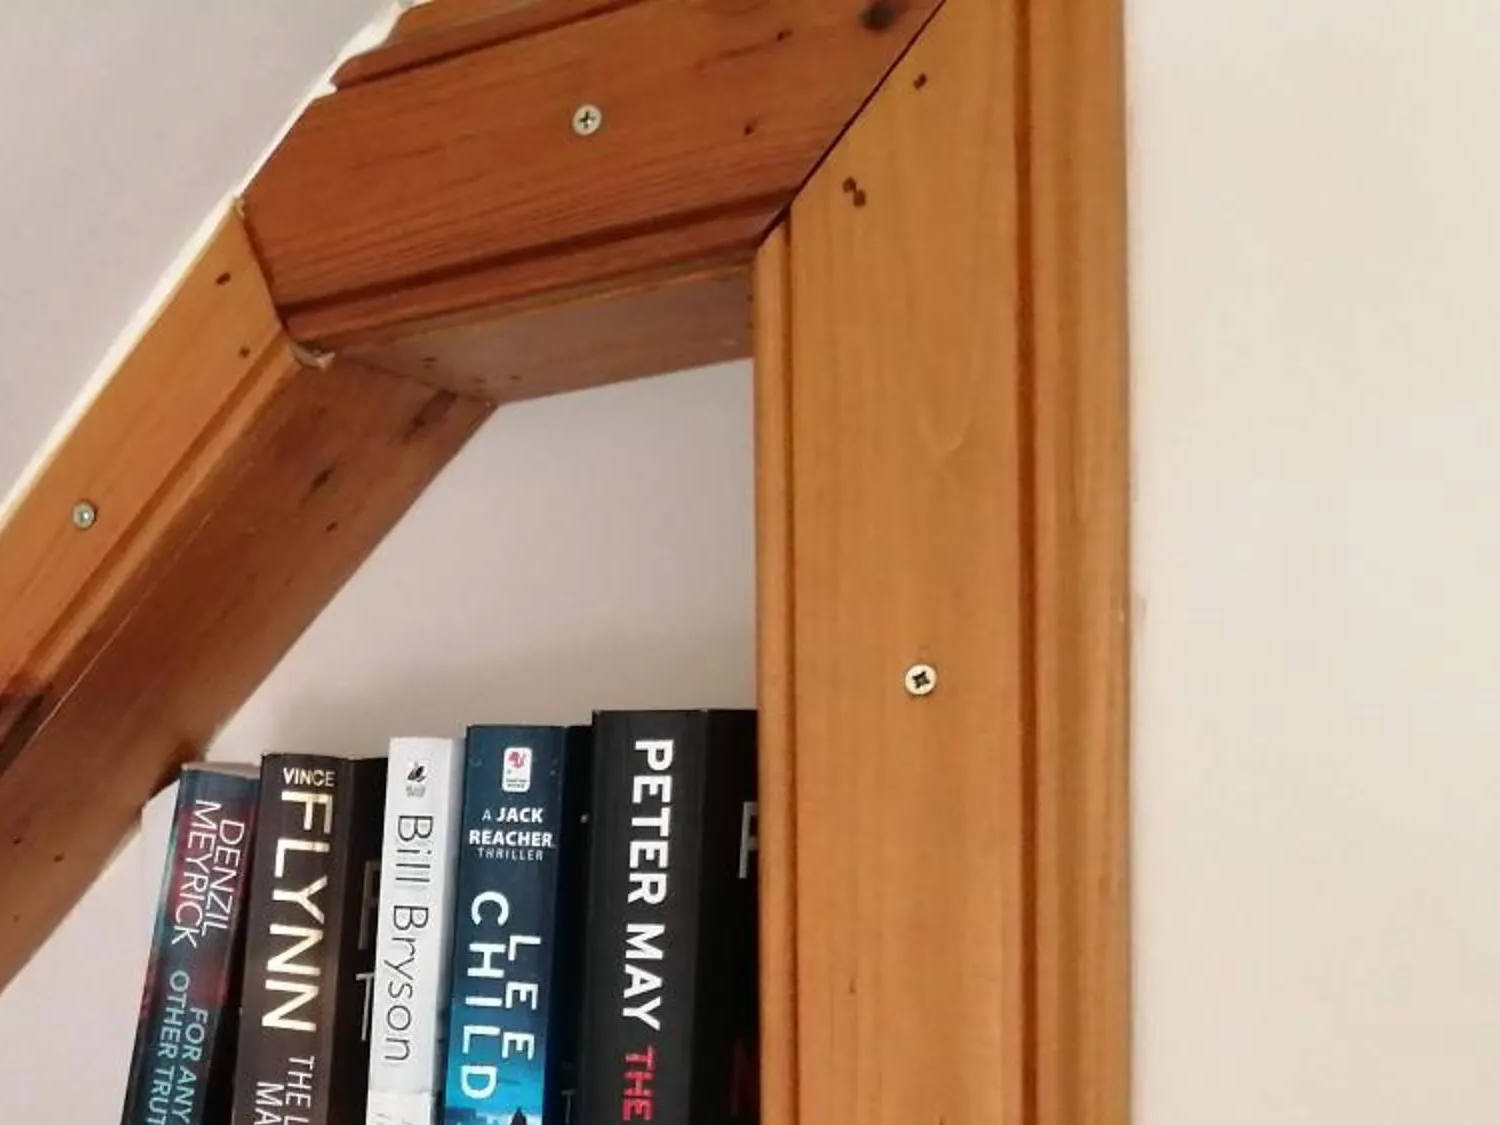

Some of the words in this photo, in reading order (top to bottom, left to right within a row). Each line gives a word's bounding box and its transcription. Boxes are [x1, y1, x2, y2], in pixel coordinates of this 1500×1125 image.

[284, 767, 336, 787] VINCE
[481, 808, 492, 822] A
[496, 807, 544, 823] JACK
[395, 815, 434, 884] Bill
[469, 829, 553, 847] REACHER
[478, 847, 544, 861] THRILLER
[628, 739, 675, 905] PETER
[171, 799, 222, 948] MEYRICK
[201, 819, 245, 937] DENZIL
[262, 790, 333, 1032] FLYNN
[156, 970, 190, 1058] OTHER
[383, 905, 429, 1062] Bryson
[460, 891, 509, 1099] CHILD
[502, 935, 541, 1060] LEE
[622, 923, 666, 1032] MAY
[182, 1007, 208, 1062] FOR
[173, 1072, 197, 1125] ANY
[285, 1055, 315, 1117] THE
[622, 1045, 657, 1121] THE
